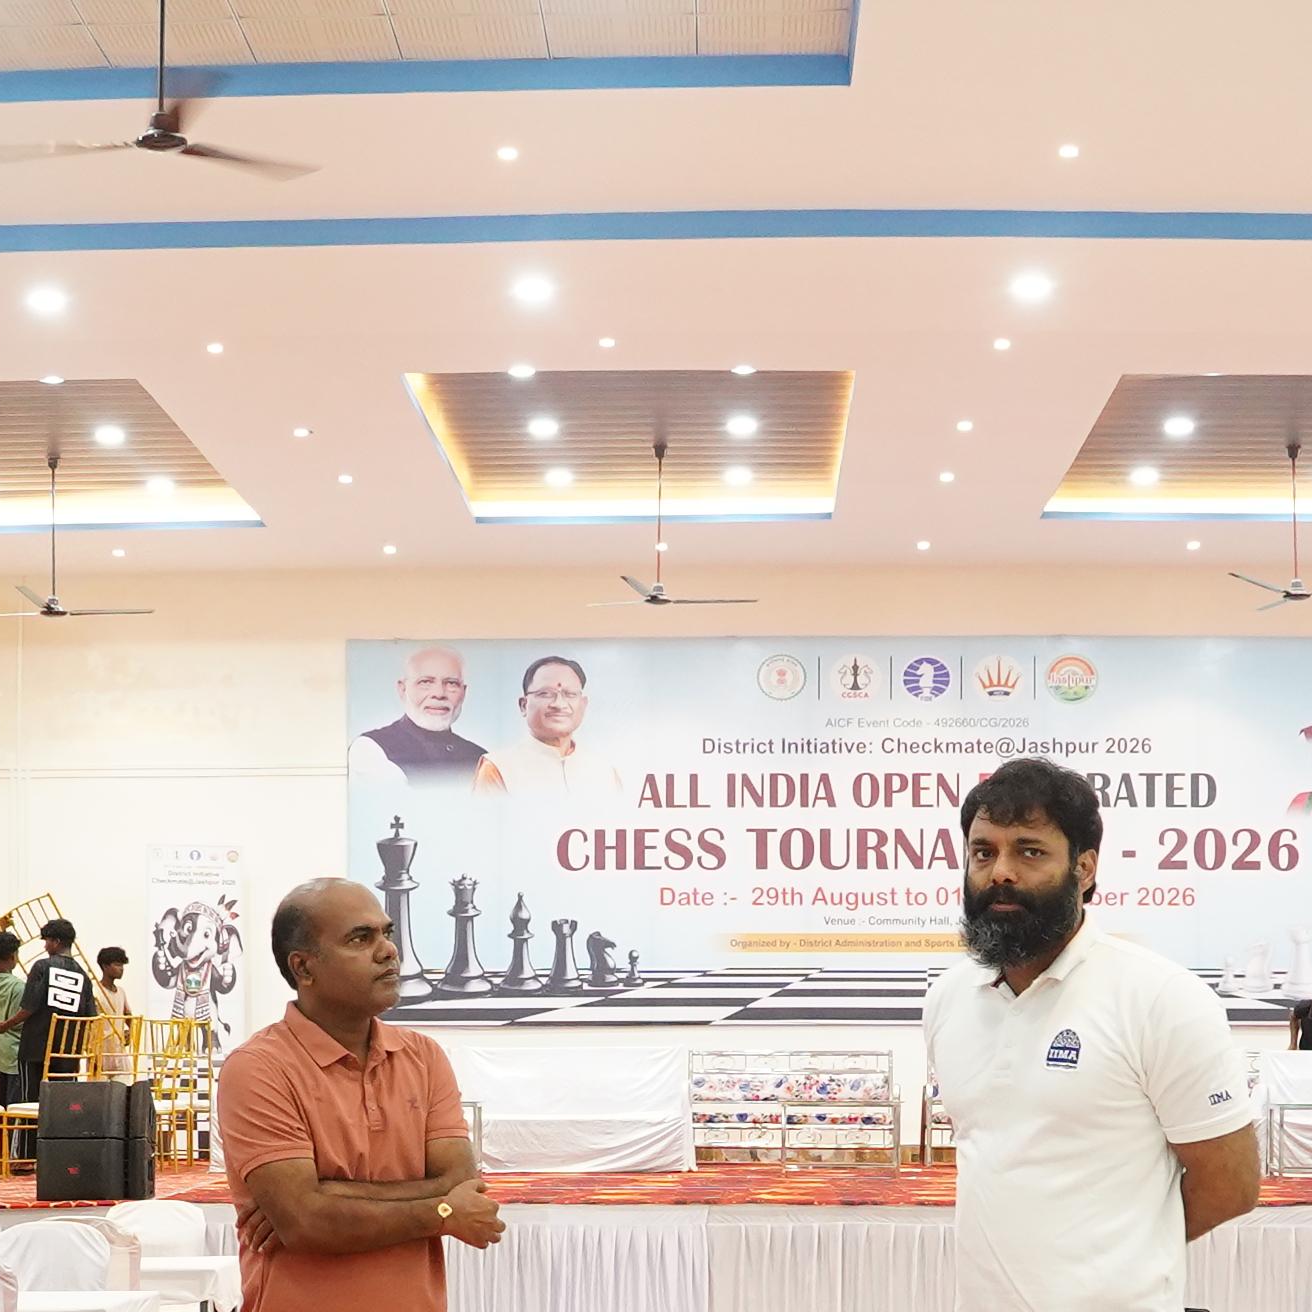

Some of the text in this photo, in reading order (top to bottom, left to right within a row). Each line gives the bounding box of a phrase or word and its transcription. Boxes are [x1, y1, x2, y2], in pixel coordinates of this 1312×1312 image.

[825, 717, 854, 728] AICF
[858, 717, 889, 728] Event
[893, 717, 923, 728] Code
[701, 737, 1152, 758] District Initiative: Checkmate@Jashpur 2026
[638, 773, 713, 809] ALL
[726, 773, 838, 809] INDIA
[851, 772, 960, 808] OPEN
[1086, 772, 1217, 808] RATED
[556, 827, 727, 872] CHESS
[1122, 849, 1137, 858] -
[1157, 827, 1300, 873] 2026
[659, 886, 714, 907] Date
[751, 886, 804, 906] 29th
[811, 886, 898, 911] August
[905, 886, 928, 906] to
[1137, 887, 1196, 907] 2026
[823, 916, 856, 926] Venue
[868, 916, 927, 928] Community
[729, 938, 777, 950] Organized
[779, 938, 791, 950] by
[799, 938, 832, 949] District
[834, 938, 901, 949] Administration
[904, 938, 922, 949] and
[924, 938, 955, 950] Sports
